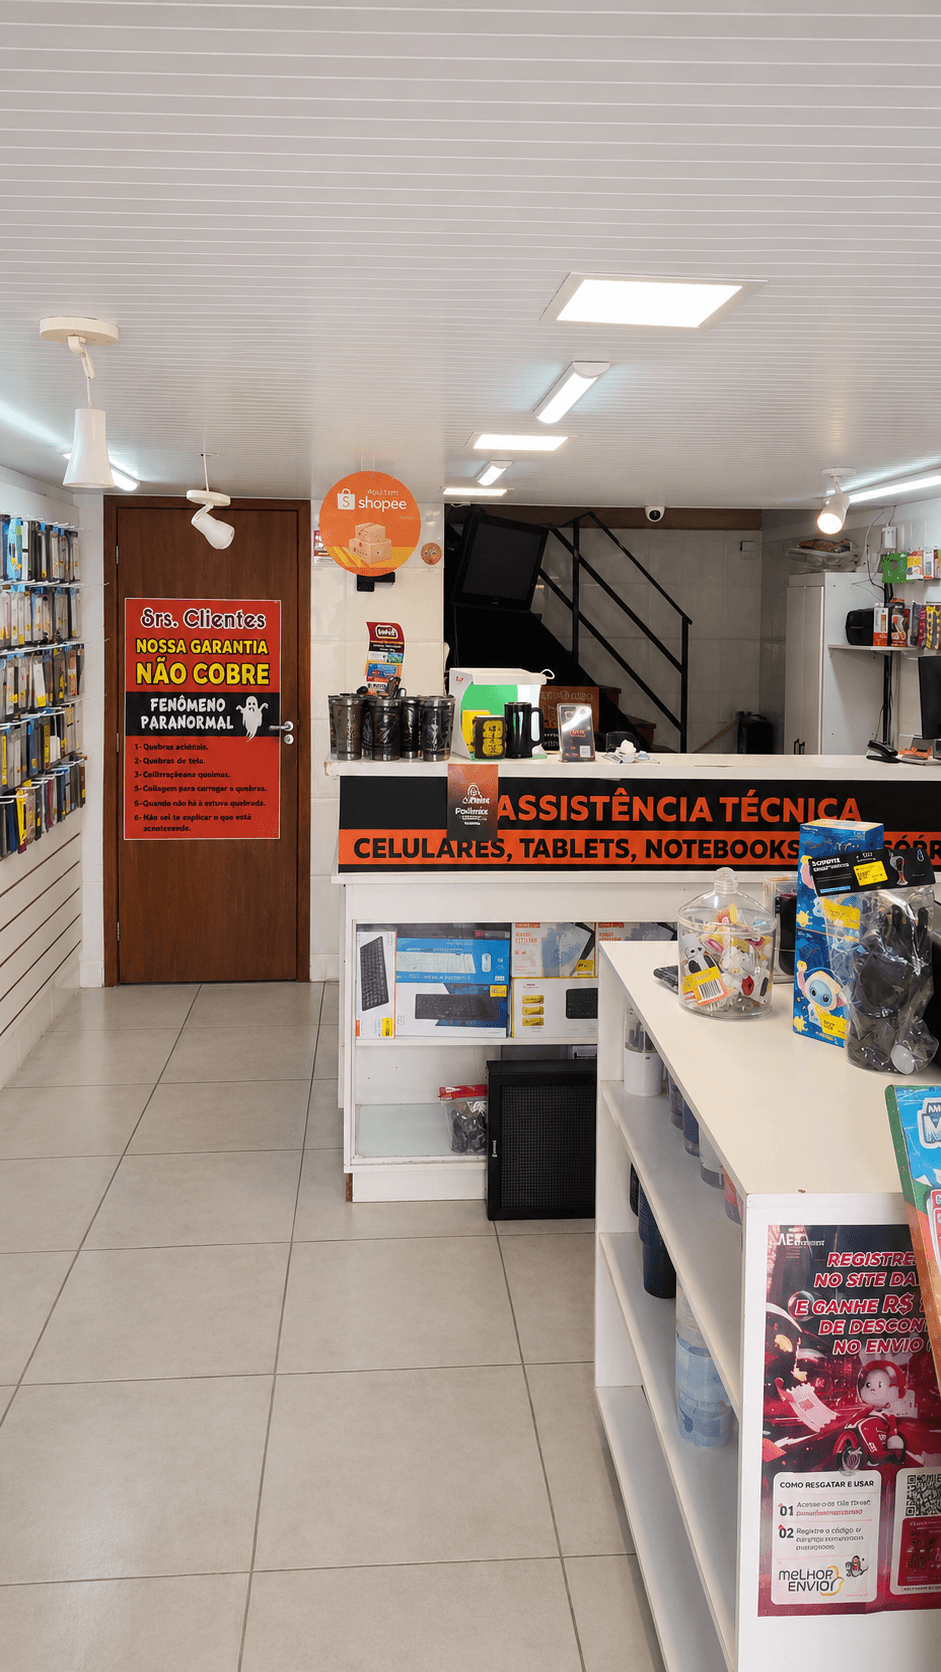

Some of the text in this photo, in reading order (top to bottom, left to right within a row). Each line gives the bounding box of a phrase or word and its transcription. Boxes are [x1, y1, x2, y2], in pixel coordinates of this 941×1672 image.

[358, 496, 407, 512] shopee
[140, 607, 267, 630] Srs. Clientes
[135, 638, 269, 655] NOSSA GARANTIA
[135, 656, 270, 686] NÃO COBRE
[149, 694, 226, 713] FENÔMENO
[140, 715, 234, 730] PARANORMAL
[143, 743, 174, 751] Quebras
[143, 757, 175, 765] Quebras
[143, 800, 171, 809] Quando
[497, 787, 862, 823] ASSISTÊNCIA TÉCNICA
[353, 838, 799, 861] CELULARES, TABLETS, NOTEBOOKS
[827, 1252, 915, 1267] REGISTRE
[814, 1272, 917, 1287] NO SITE DA
[795, 1292, 914, 1315] E GANHE R$
[818, 1318, 929, 1335] DE DESCON
[832, 1337, 925, 1355] NO ENVIO
[780, 1506, 794, 1516] 01
[779, 1528, 794, 1538] 02
[788, 1581, 830, 1592] ENVIO
